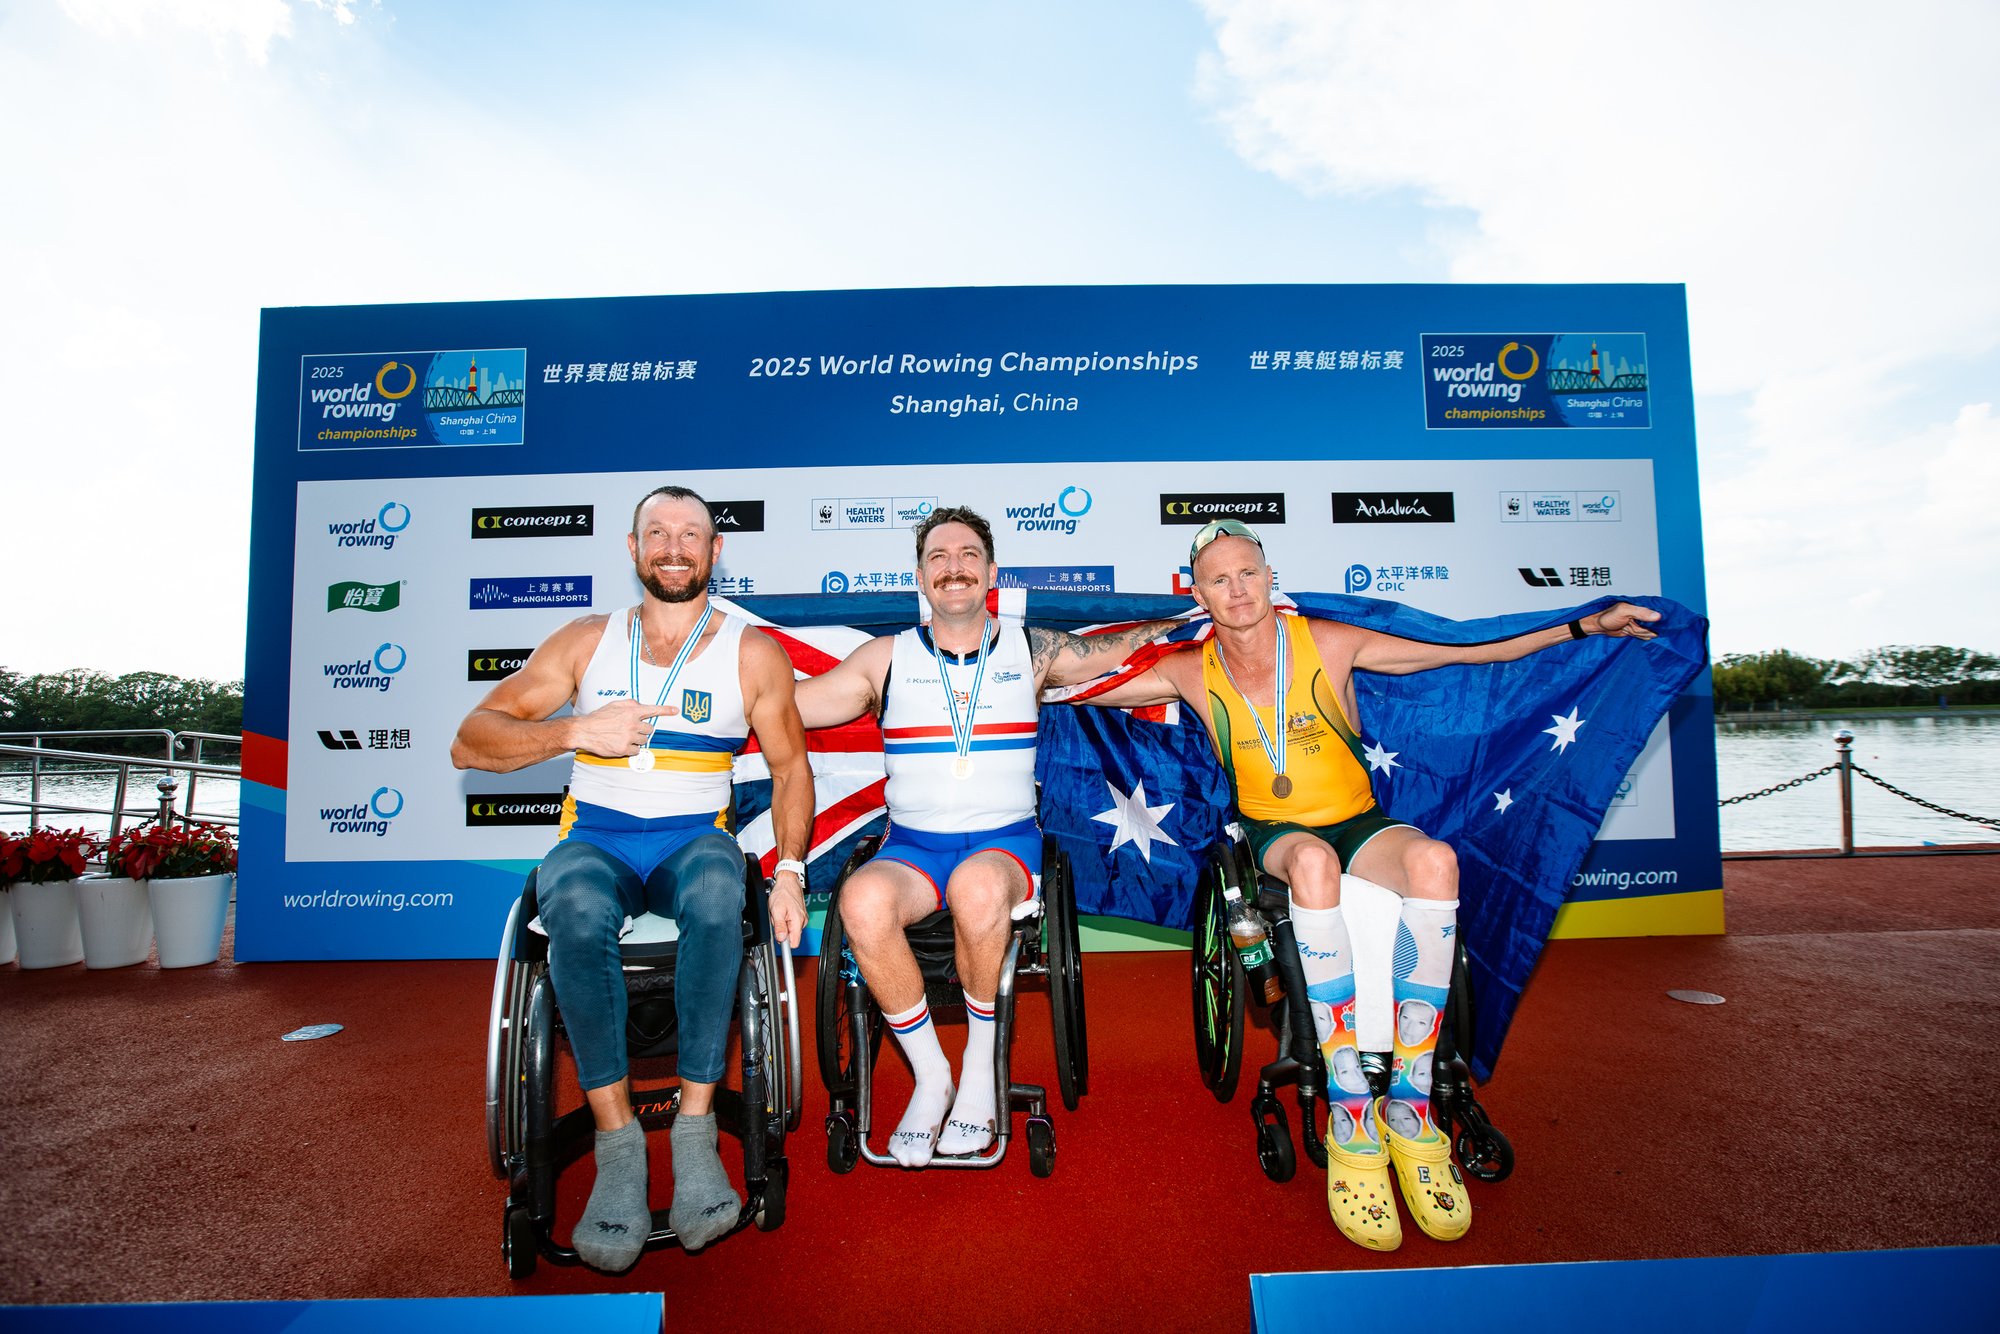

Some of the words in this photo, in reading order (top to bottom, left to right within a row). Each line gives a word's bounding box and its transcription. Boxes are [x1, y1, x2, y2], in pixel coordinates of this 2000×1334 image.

[1431, 345, 1465, 357] 2025
[749, 357, 811, 377] 2025
[819, 354, 893, 375] World
[900, 353, 993, 378] Rowing
[1000, 350, 1199, 375] Championships
[1249, 350, 1405, 371] 世界赛艇锦标赛
[311, 366, 345, 379] 2025
[542, 359, 698, 384] 世界赛艇锦标赛
[1433, 363, 1495, 382] world
[311, 382, 372, 403] world
[1447, 382, 1522, 402] rowing
[322, 400, 397, 422] rowing
[889, 394, 1006, 418] Shanghai,
[1012, 392, 1079, 413] China
[1567, 398, 1610, 410] Shanghai
[1612, 396, 1643, 407] China
[440, 416, 484, 427] Shanghai
[486, 413, 517, 424] China
[1444, 407, 1546, 422] championships
[317, 425, 418, 442] championships
[846, 507, 885, 516] HEALTHY
[897, 508, 918, 516] world
[1006, 504, 1056, 519] world
[1193, 500, 1265, 516] concept
[1266, 500, 1277, 514] 2
[1355, 498, 1432, 518] Andalucía
[1533, 500, 1570, 508] HEALTHY
[1536, 508, 1571, 516] WATERS
[328, 519, 376, 535] world
[503, 514, 572, 528] concept
[575, 514, 586, 527] 2
[848, 515, 885, 523] WATERS
[1016, 519, 1078, 535] rowing
[337, 535, 395, 551] rowing
[854, 572, 918, 587] 太平洋保
[1047, 572, 1096, 583] 上海赛事
[1376, 565, 1450, 582] 太平洋保险
[1569, 566, 1612, 587] 理想
[526, 581, 575, 594] 上海赛事
[1376, 582, 1406, 592] CPIC
[512, 594, 588, 604] SHANGHAISPORTS
[323, 660, 372, 676] world
[333, 676, 391, 692] rowing
[368, 728, 411, 750] 理想
[1303, 744, 1320, 756] 759
[319, 804, 368, 820] world
[499, 803, 562, 815] concep
[329, 820, 388, 837] rowing
[1572, 868, 1678, 890] owing.com
[283, 889, 453, 911] worldrowing.com
[948, 1119, 992, 1134] KUKR
[1417, 1166, 1431, 1183] E
